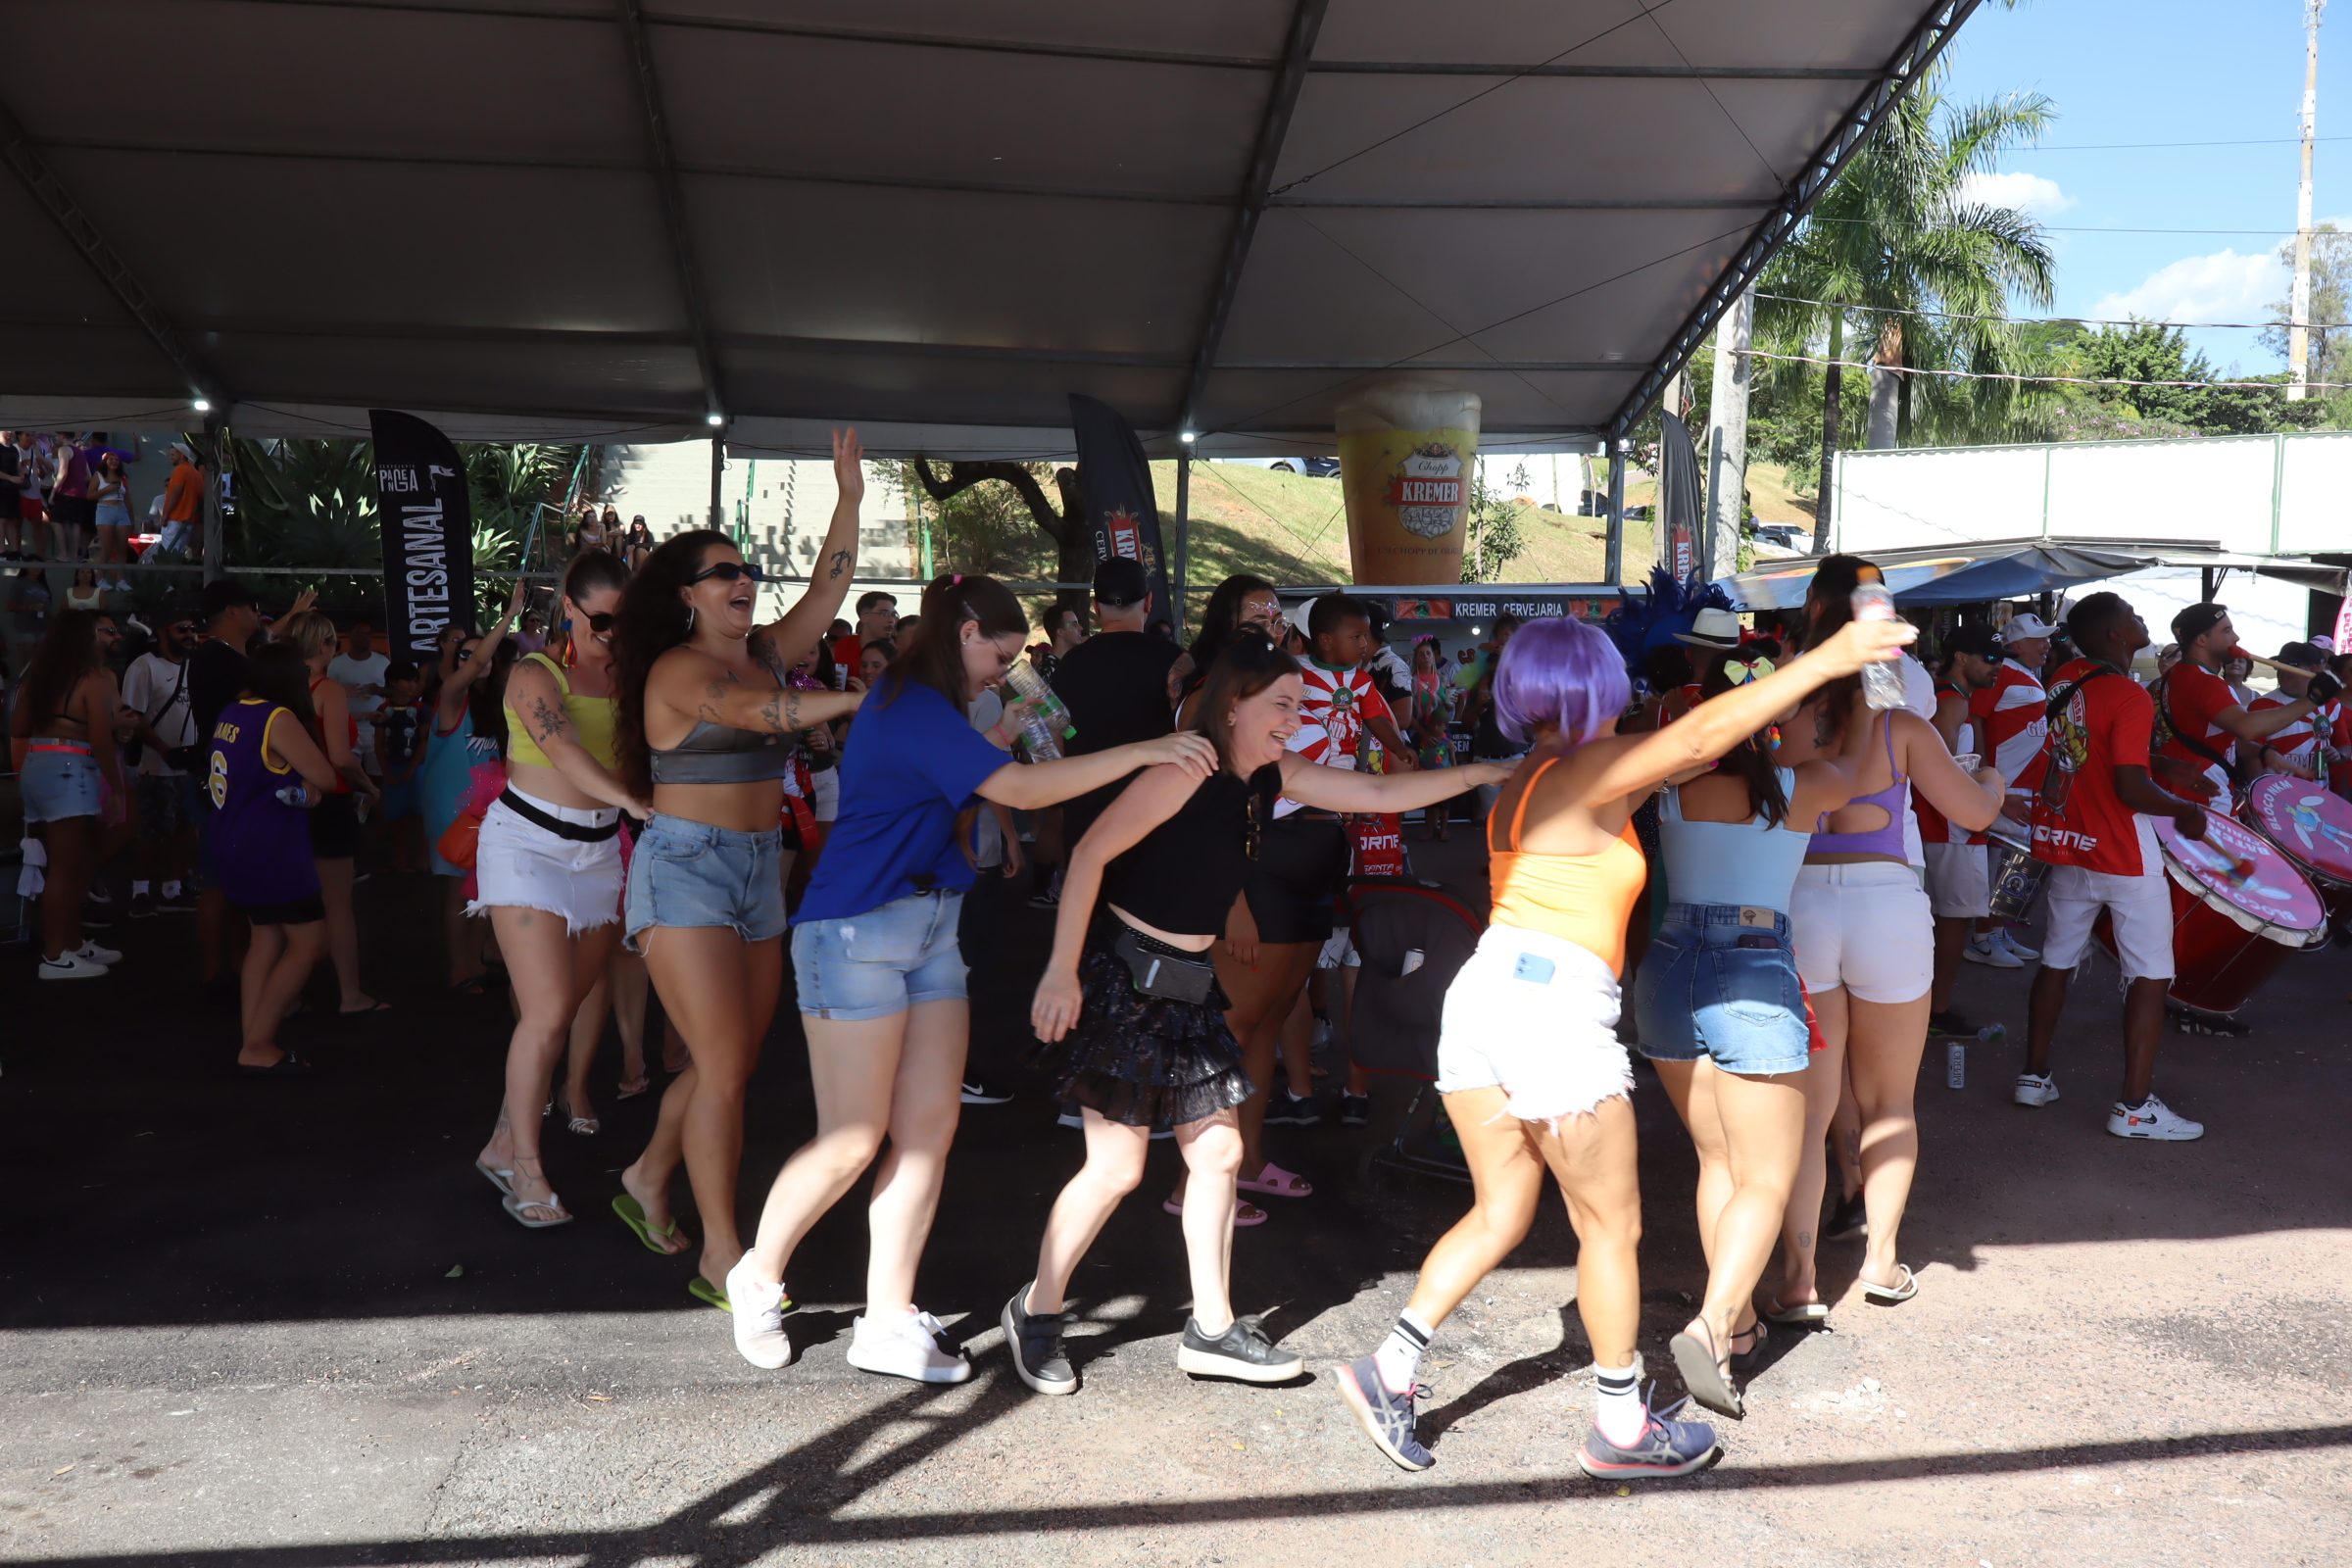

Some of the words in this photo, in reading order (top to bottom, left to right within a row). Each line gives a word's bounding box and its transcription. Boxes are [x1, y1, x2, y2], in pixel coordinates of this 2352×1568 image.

[1418, 461, 1449, 475] Chopp
[1401, 481, 1459, 503] KREMER
[1095, 530, 1108, 563] CERV
[401, 498, 450, 652] ARTESANAL
[1455, 602, 1497, 617] KREMER
[1502, 602, 1564, 617] CERVEJARIA
[209, 750, 227, 810] 6
[2266, 779, 2294, 797] NKM
[2263, 792, 2282, 832] BLOCO
[2182, 858, 2230, 894] NKM
[2232, 892, 2298, 923] BLOCO
